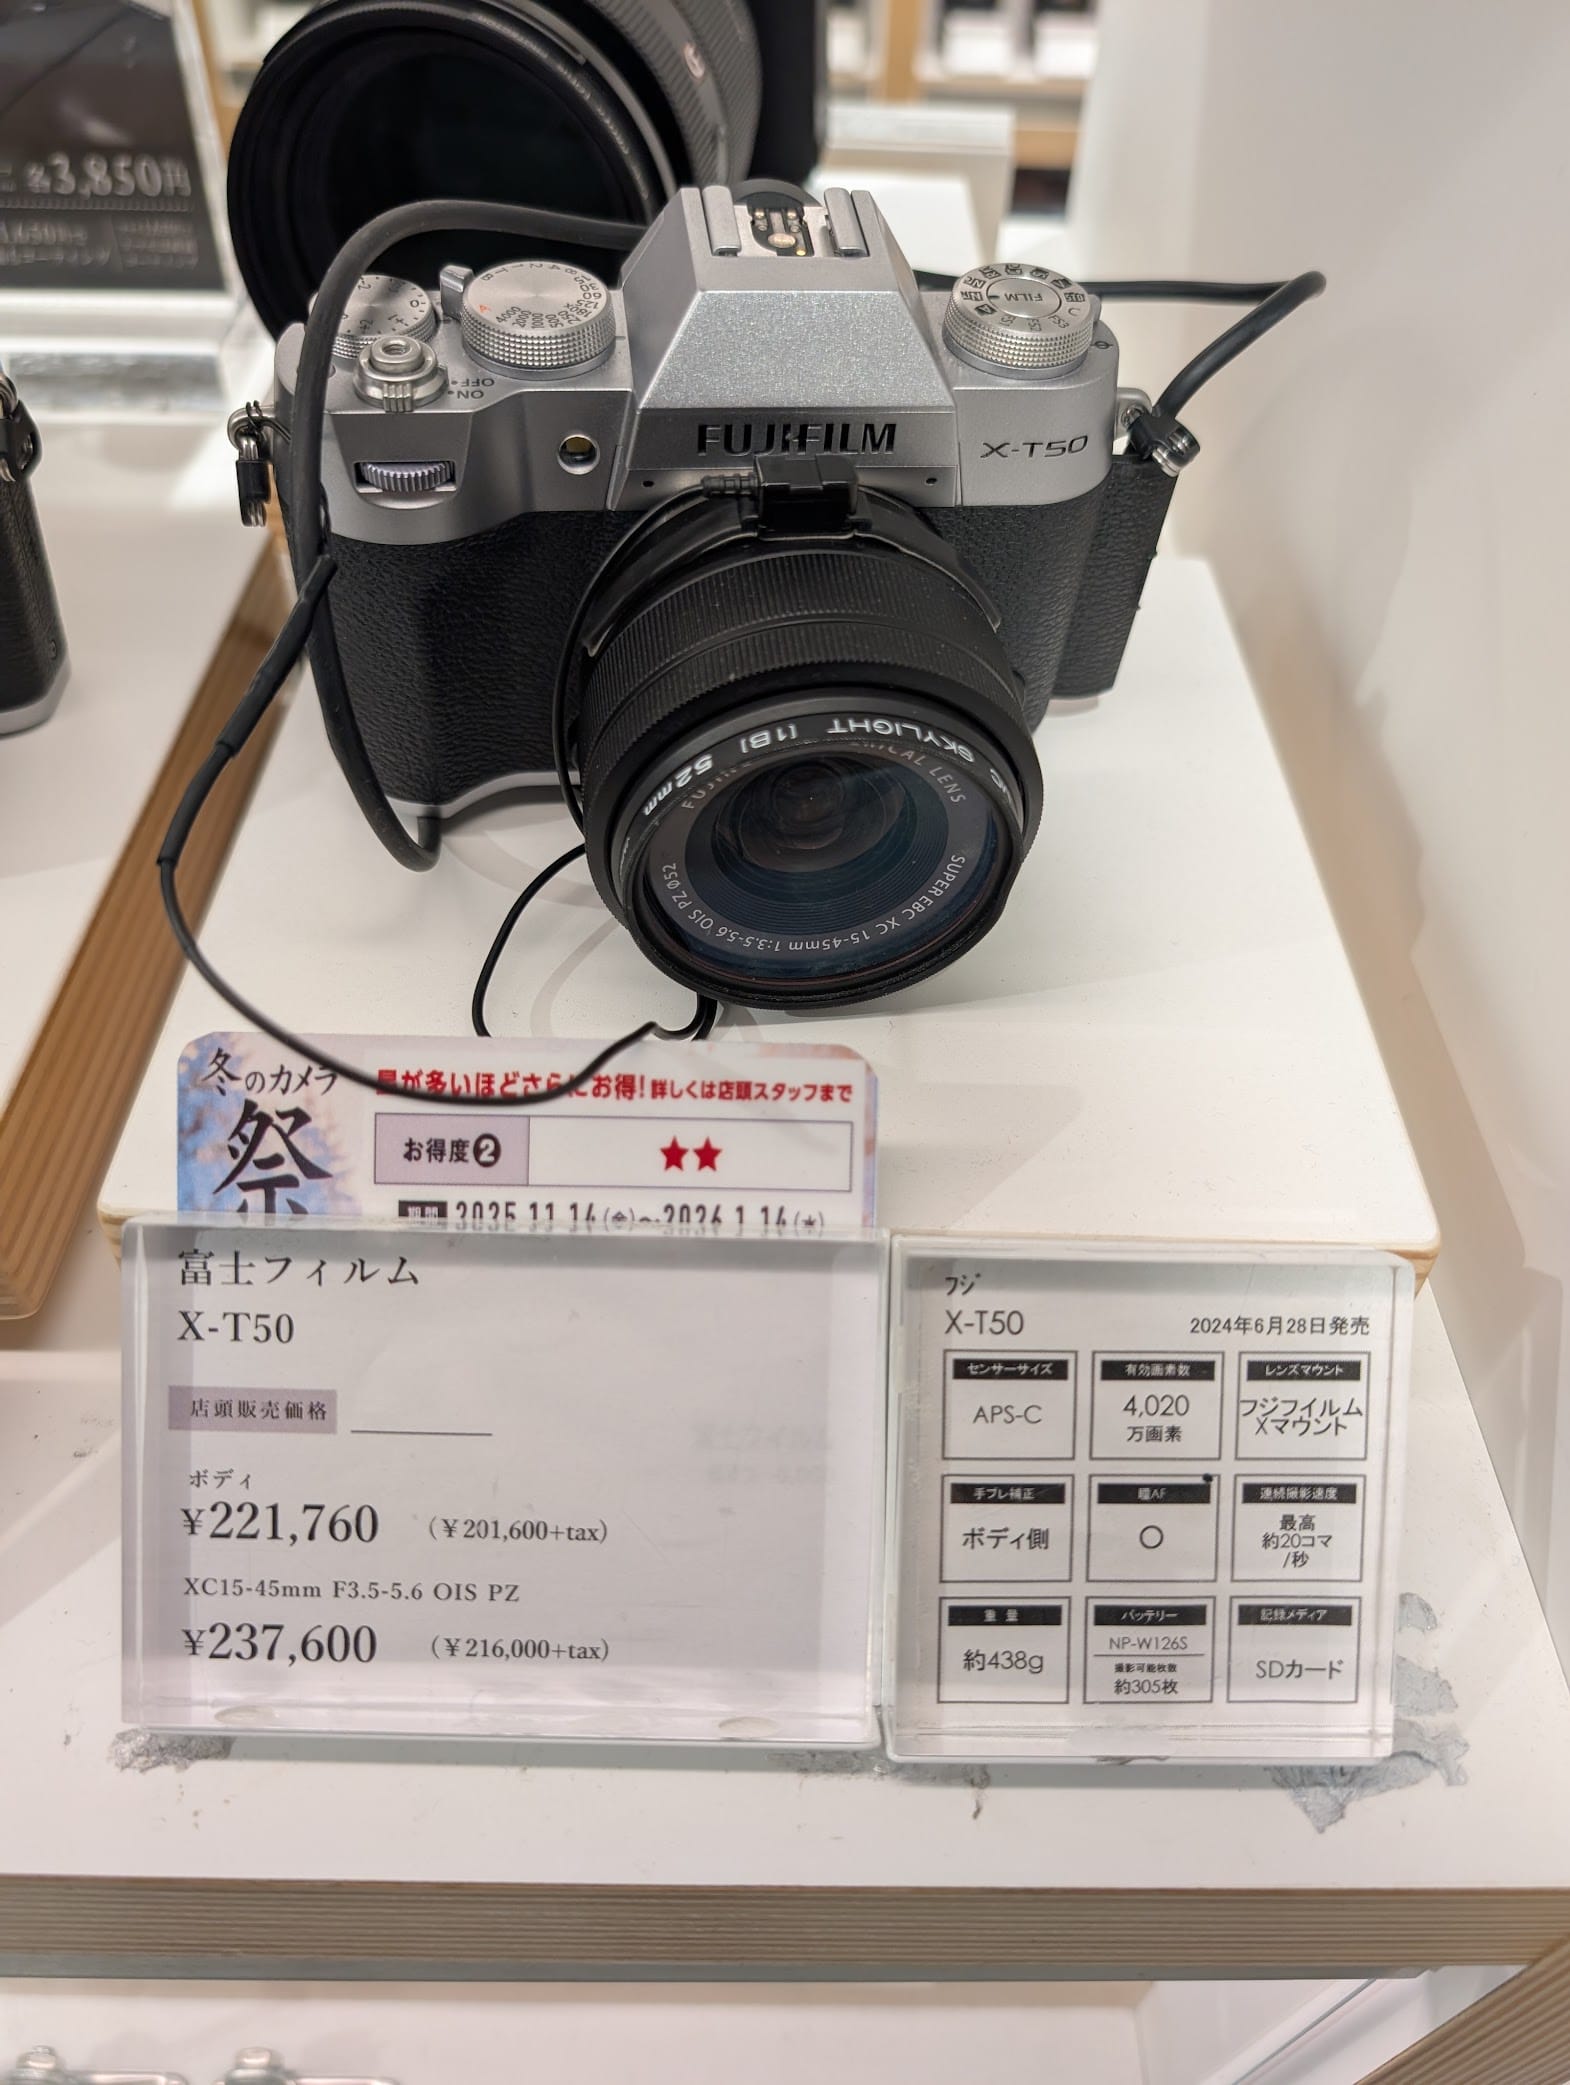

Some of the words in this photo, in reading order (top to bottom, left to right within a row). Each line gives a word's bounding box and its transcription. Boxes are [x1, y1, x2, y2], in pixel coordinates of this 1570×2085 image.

[1004, 293, 1043, 302] FILM
[696, 423, 897, 457] FUJIFILM
[979, 435, 1088, 460] X-T50
[827, 716, 976, 764] SKYLIGHT
[928, 765, 967, 804] LENS
[932, 854, 968, 899] SUPER
[672, 889, 694, 911] PZ
[902, 892, 934, 920] EBC
[687, 908, 714, 932] OIS
[874, 916, 900, 937] XC
[714, 925, 783, 953] 1:3.5-5.6
[788, 927, 871, 952] 15-45mm
[200, 1046, 339, 1098] 冬のカメラ
[213, 1099, 334, 1215] 祭
[177, 1248, 419, 1287] 富士フィルム
[177, 1310, 294, 1344] X-T50
[944, 1309, 1025, 1336] X-T50
[1189, 1315, 1370, 1336] 2024年6月28日発売
[966, 1362, 1053, 1376] センサーサイズ
[1265, 1361, 1344, 1377] レンズマウント
[189, 1397, 327, 1421] 店頭販売価格
[972, 1404, 1043, 1425] APS-C
[1122, 1393, 1190, 1419] 4,020
[1126, 1425, 1182, 1443] 万画素
[1254, 1415, 1350, 1438] Xマウント
[188, 1467, 251, 1491] ボディ
[973, 1486, 1036, 1501] 手ブレ補正
[180, 1500, 379, 1547] ¥221,760
[1279, 1513, 1316, 1532] 最高
[962, 1526, 1050, 1551] ボディ側
[1259, 1532, 1335, 1551] 約20コマ
[1282, 1550, 1310, 1569] /秒
[183, 1577, 322, 1598] XC15-45mm
[332, 1580, 423, 1601] F3.5-5.6
[432, 1582, 477, 1602] OIS
[488, 1583, 520, 1603] PZ
[1260, 1607, 1329, 1623] 記録メディア
[181, 1622, 377, 1667] ¥237,600
[1109, 1635, 1188, 1651] NP-W126S
[962, 1648, 1044, 1675] 約438g
[1255, 1658, 1344, 1680] SDカード
[1113, 1678, 1179, 1695] 約305枚
